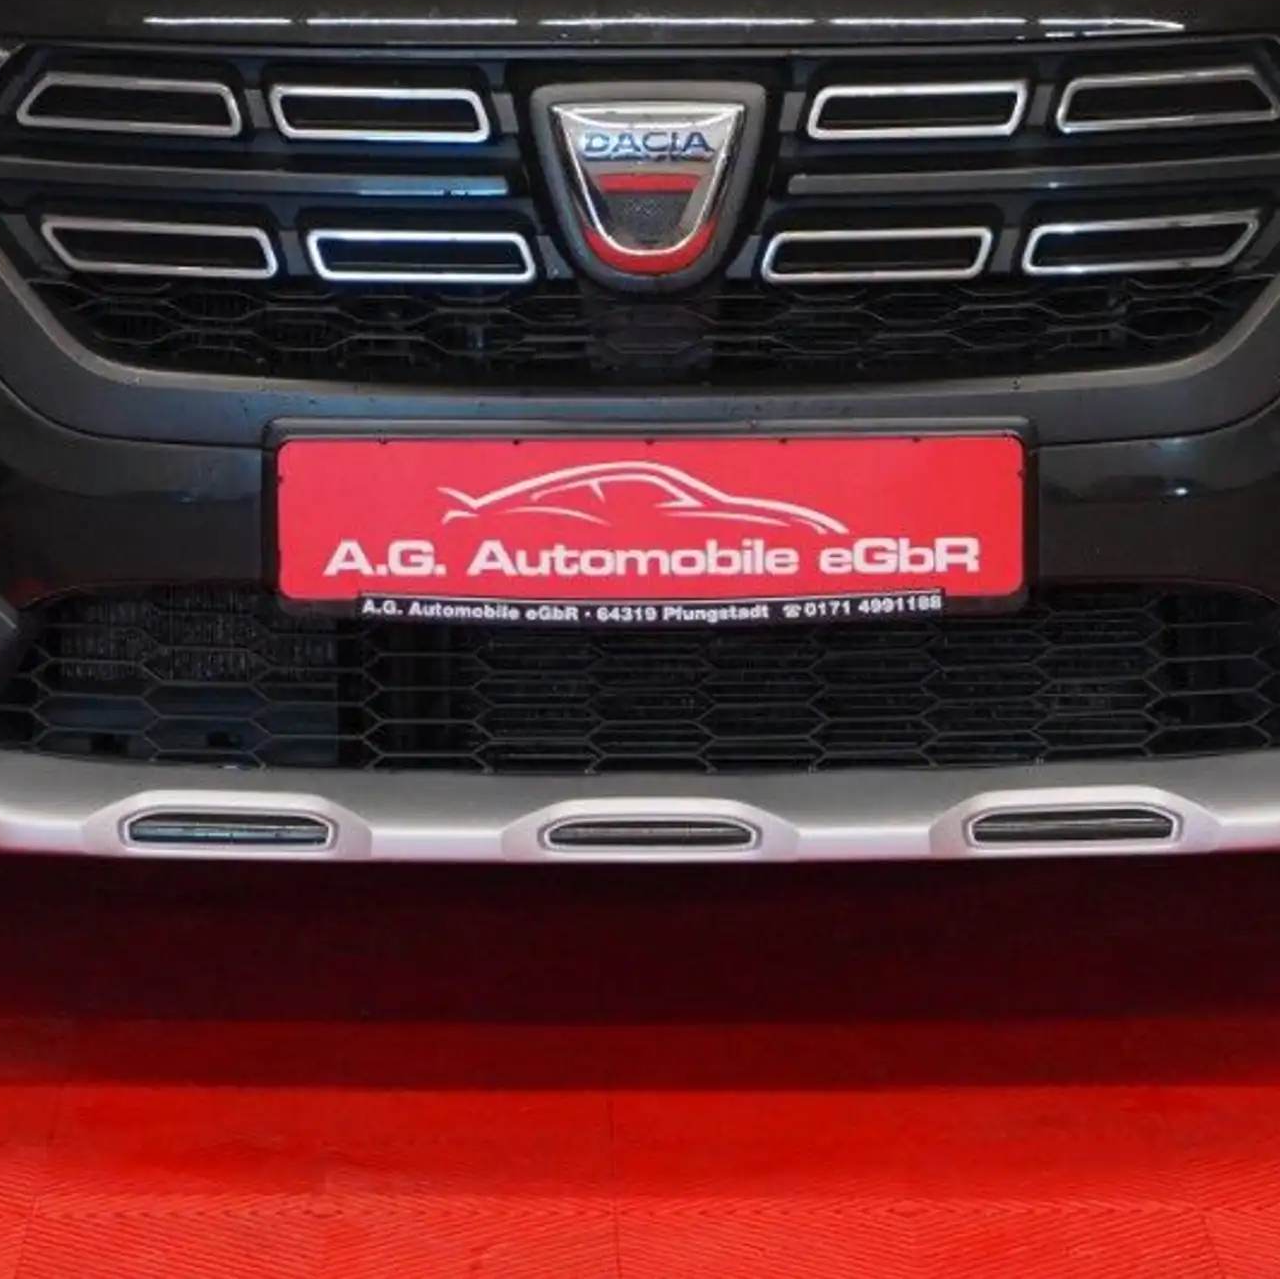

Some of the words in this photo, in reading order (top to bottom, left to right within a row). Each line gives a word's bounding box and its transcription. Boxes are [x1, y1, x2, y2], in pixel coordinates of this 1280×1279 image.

[583, 131, 716, 154] DACIA
[323, 539, 447, 576] A.G.
[467, 539, 800, 576] Automobile
[819, 537, 981, 574] eGbR
[361, 599, 404, 616] A.G.
[408, 601, 520, 620] Automobile
[525, 605, 579, 621] eGbR
[596, 606, 657, 622] 64319
[663, 604, 770, 624] Pfungstadt
